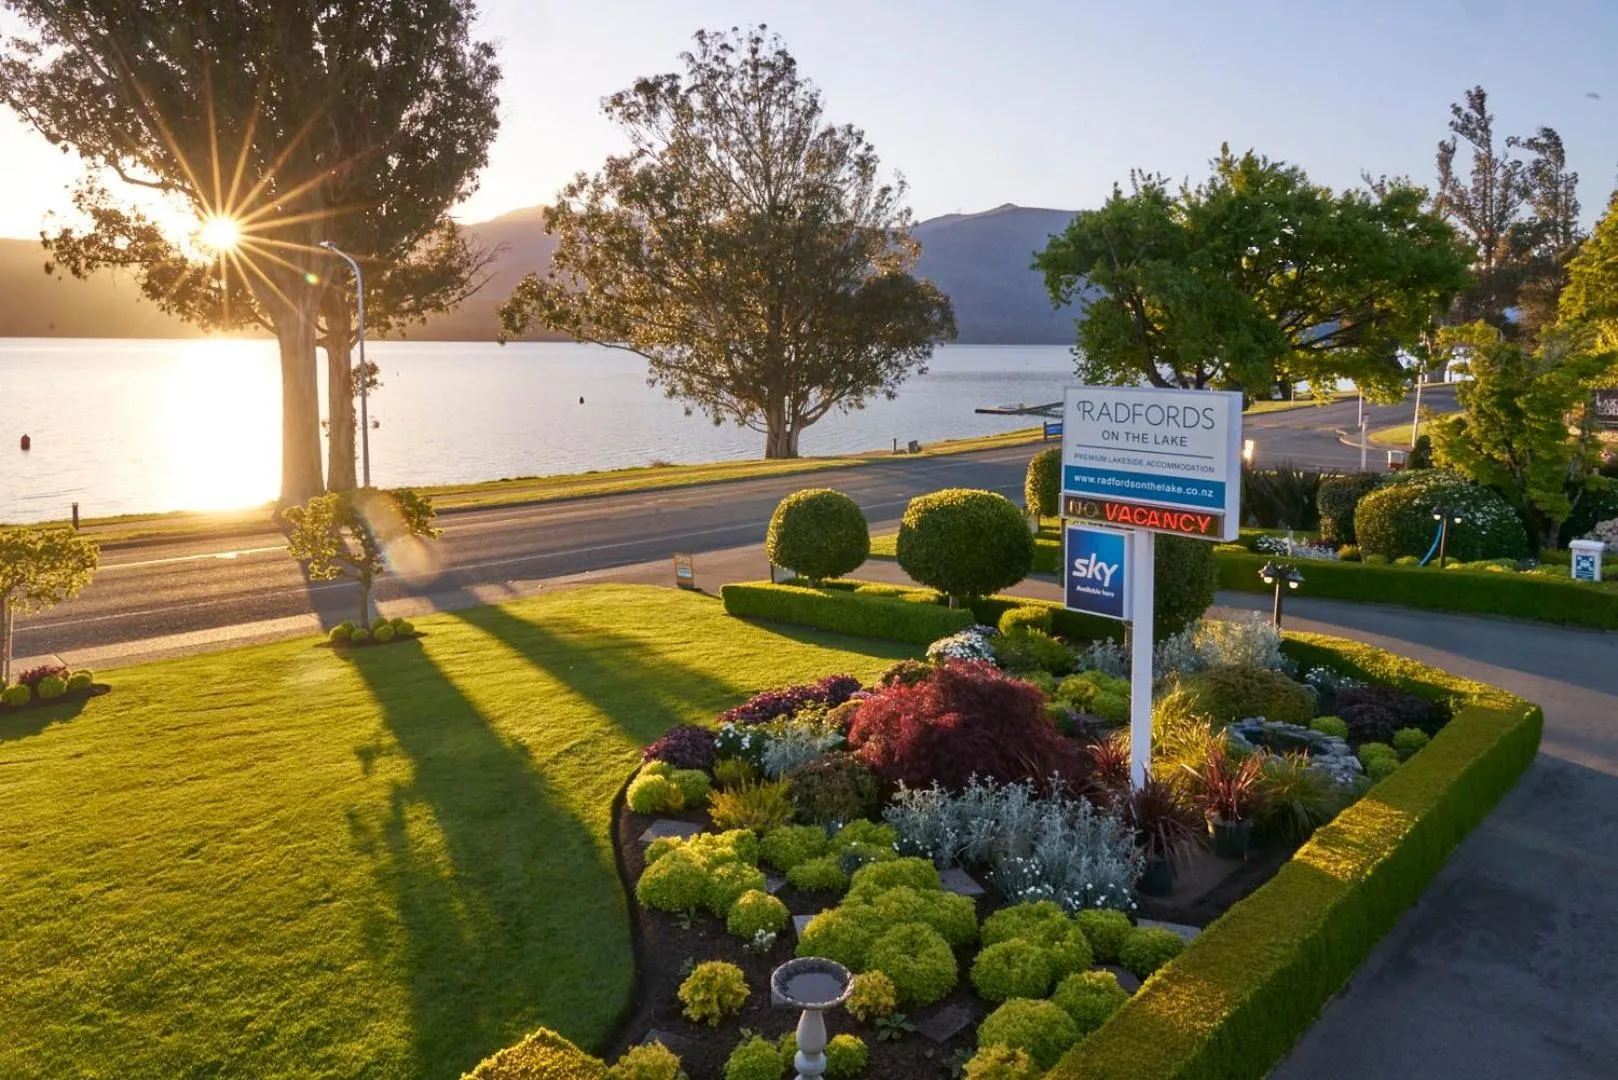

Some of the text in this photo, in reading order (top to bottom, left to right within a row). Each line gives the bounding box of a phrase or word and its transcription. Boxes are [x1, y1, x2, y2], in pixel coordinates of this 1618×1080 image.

[1077, 400, 1215, 430] RADFORDS
[1101, 430, 1188, 447] ON THE LAKE
[1074, 453, 1215, 473] PREMIUM LAKESIDE ACCOMMODATION
[1074, 474, 1214, 497] www.radfordsonthelake.co.nz
[1069, 500, 1098, 518] NO
[1104, 503, 1212, 533] VACANCY
[1072, 552, 1119, 587] sky
